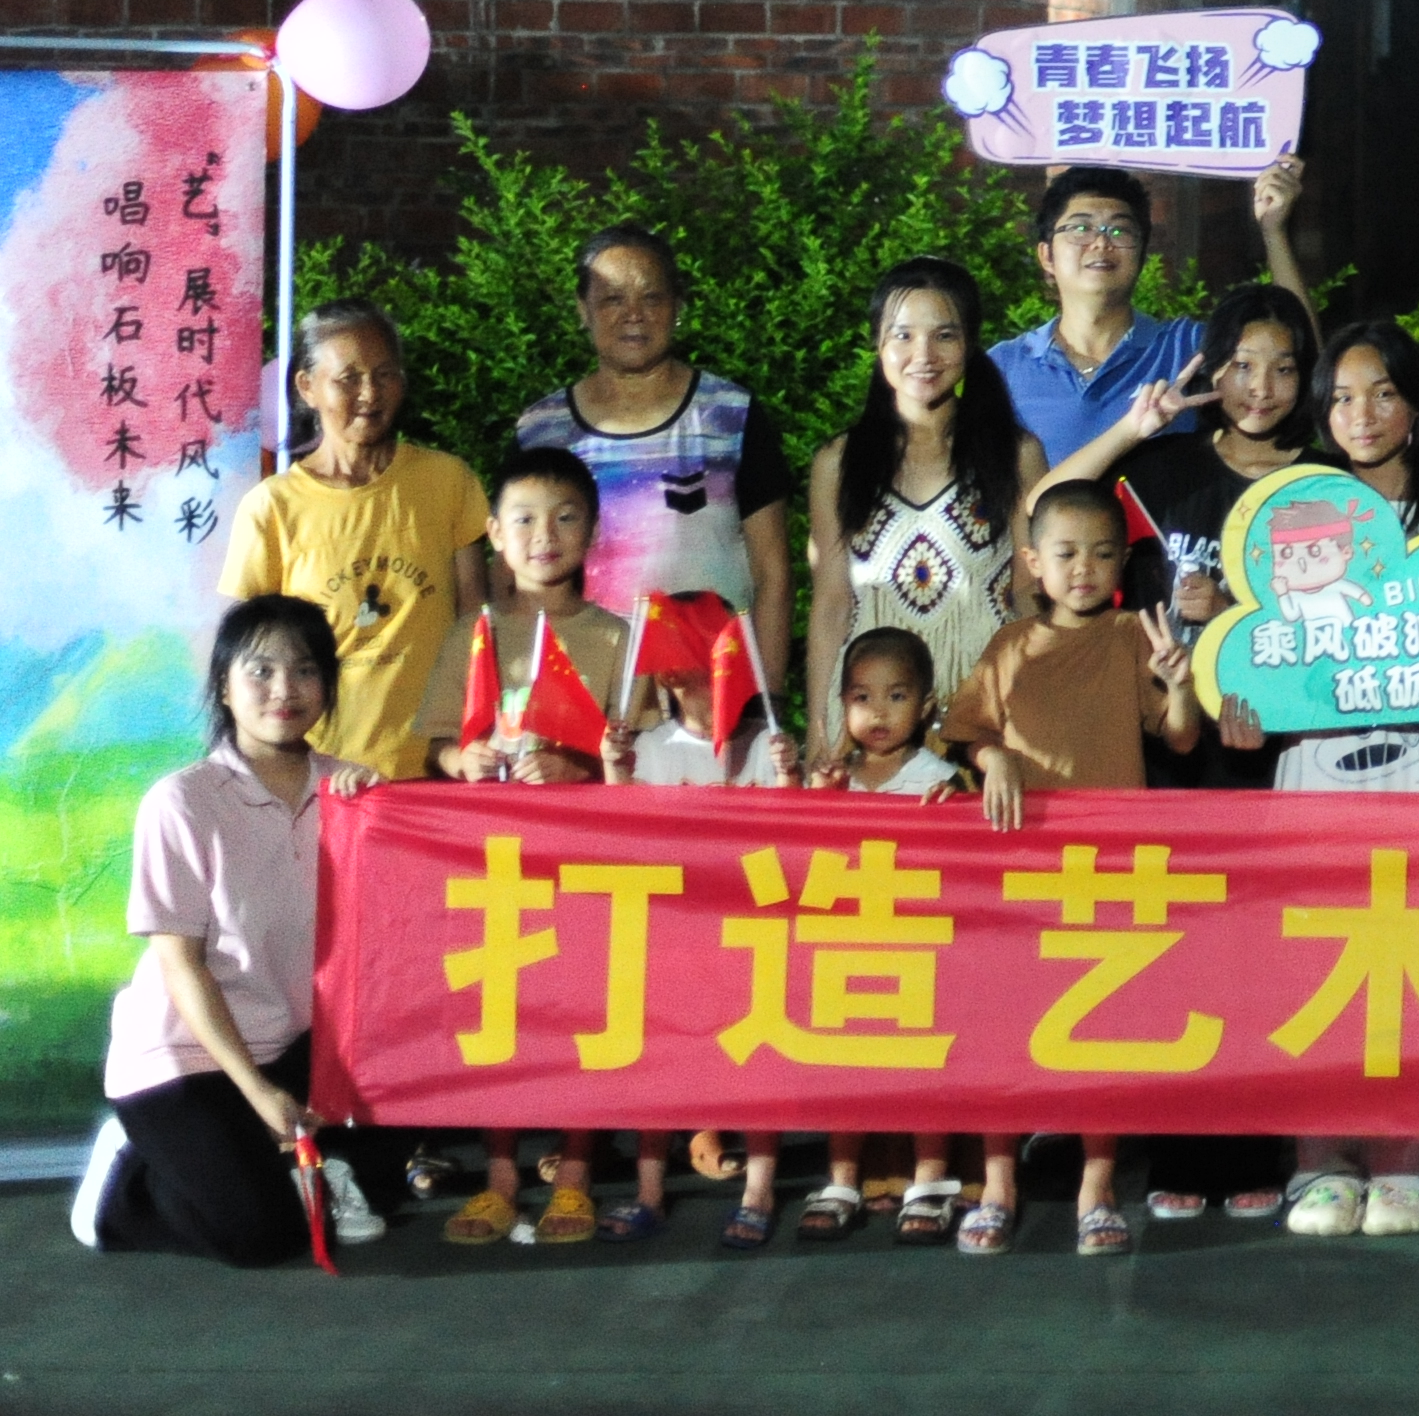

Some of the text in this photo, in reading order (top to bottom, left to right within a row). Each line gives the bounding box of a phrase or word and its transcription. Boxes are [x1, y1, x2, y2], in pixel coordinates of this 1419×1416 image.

[1033, 43, 1231, 89] 青春飞扬
[1055, 99, 1268, 149] 梦想起航
[100, 180, 151, 532] 唱响石板未来
